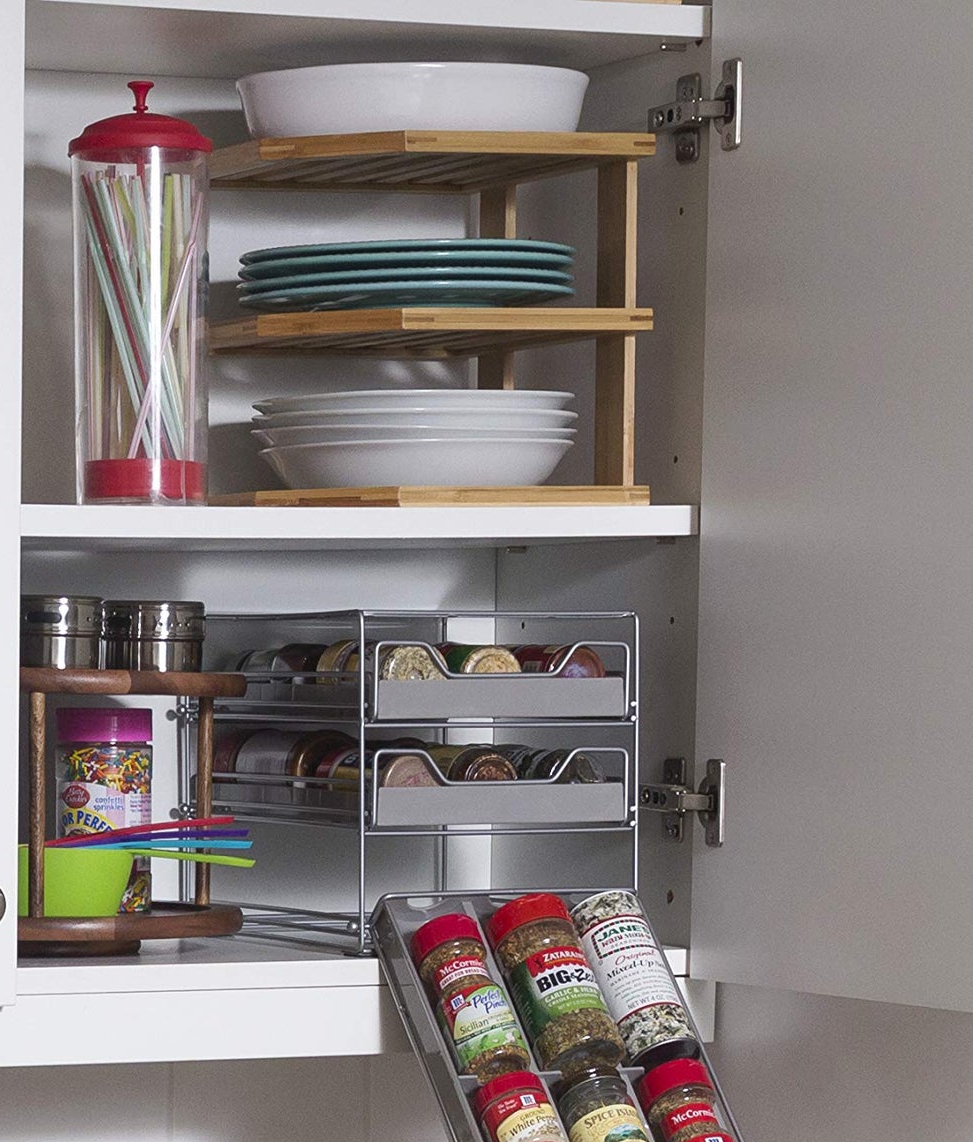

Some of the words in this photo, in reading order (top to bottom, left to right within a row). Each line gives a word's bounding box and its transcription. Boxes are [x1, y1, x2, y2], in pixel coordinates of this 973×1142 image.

[93, 803, 124, 812] sprinkles
[615, 950, 656, 966] Original
[606, 960, 655, 979] Mixed-Up
[536, 969, 572, 993] BIG
[472, 989, 500, 1008] Perfect
[544, 987, 573, 1002] GARLIC
[459, 1018, 489, 1035] Sicilian
[509, 1118, 535, 1137] White
[584, 1109, 615, 1129] SPICE
